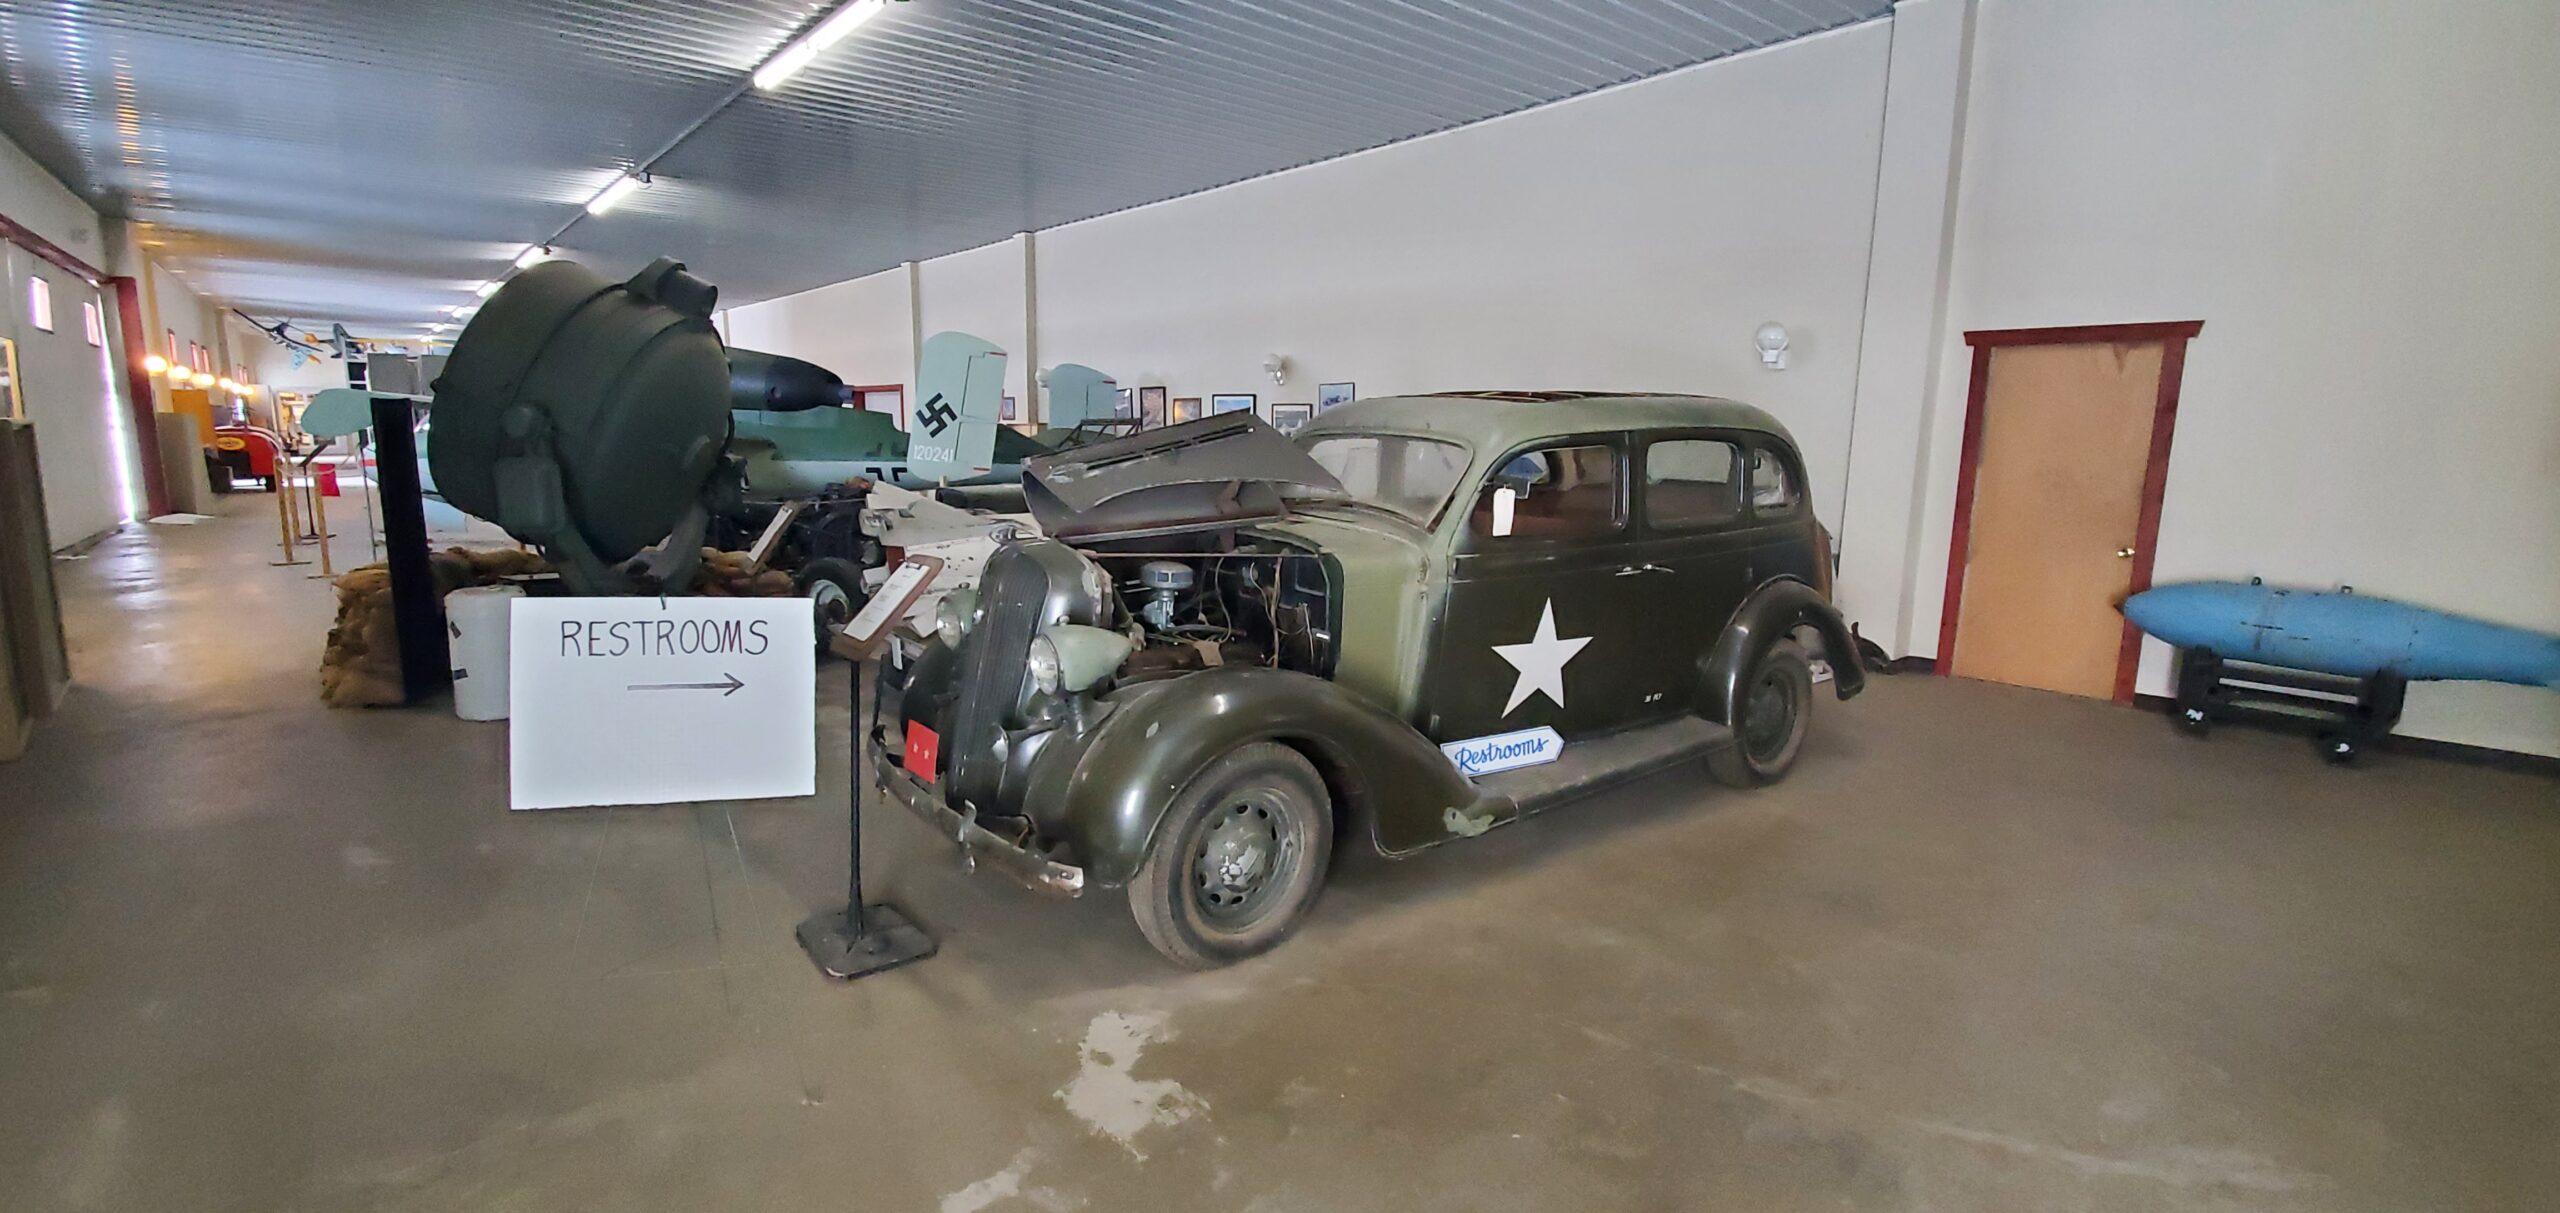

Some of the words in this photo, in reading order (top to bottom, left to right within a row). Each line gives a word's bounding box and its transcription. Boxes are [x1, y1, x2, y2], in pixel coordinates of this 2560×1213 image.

[913, 444, 954, 463] 120241
[560, 619, 769, 657] RESTROOMS
[1454, 737, 1550, 773] Restrooms
